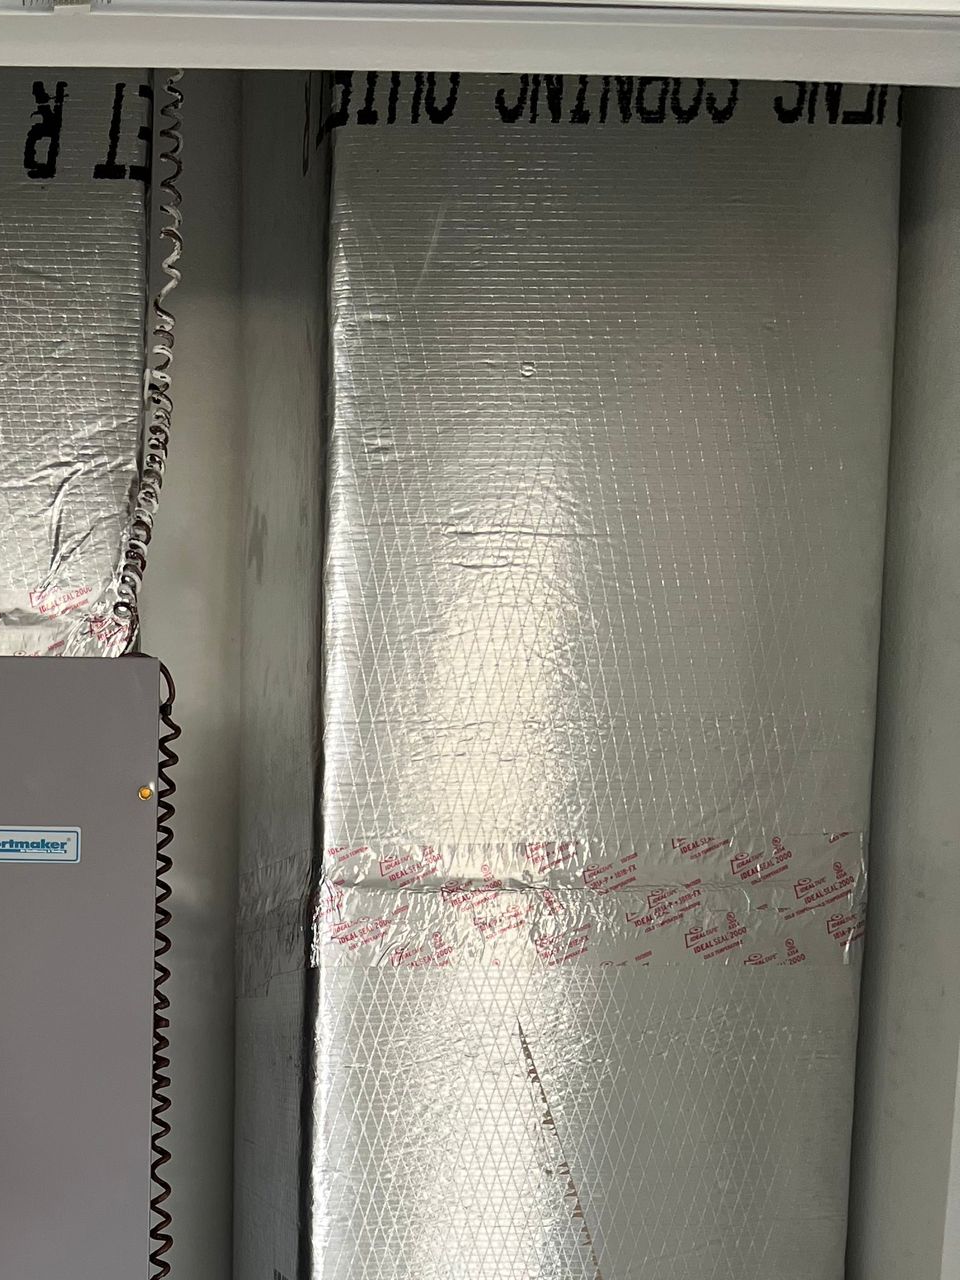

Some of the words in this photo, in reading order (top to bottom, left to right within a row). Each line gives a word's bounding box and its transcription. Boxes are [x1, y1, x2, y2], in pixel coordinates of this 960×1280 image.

[760, 860, 775, 873] SEAL
[775, 850, 792, 864] 2000
[804, 892, 823, 905] IDEAL
[823, 884, 839, 896] SEAL
[838, 876, 855, 889] 2000
[693, 940, 713, 954] IDEAL
[713, 935, 729, 946] SEAL
[730, 927, 747, 939] 2000
[789, 953, 806, 966] 2000
